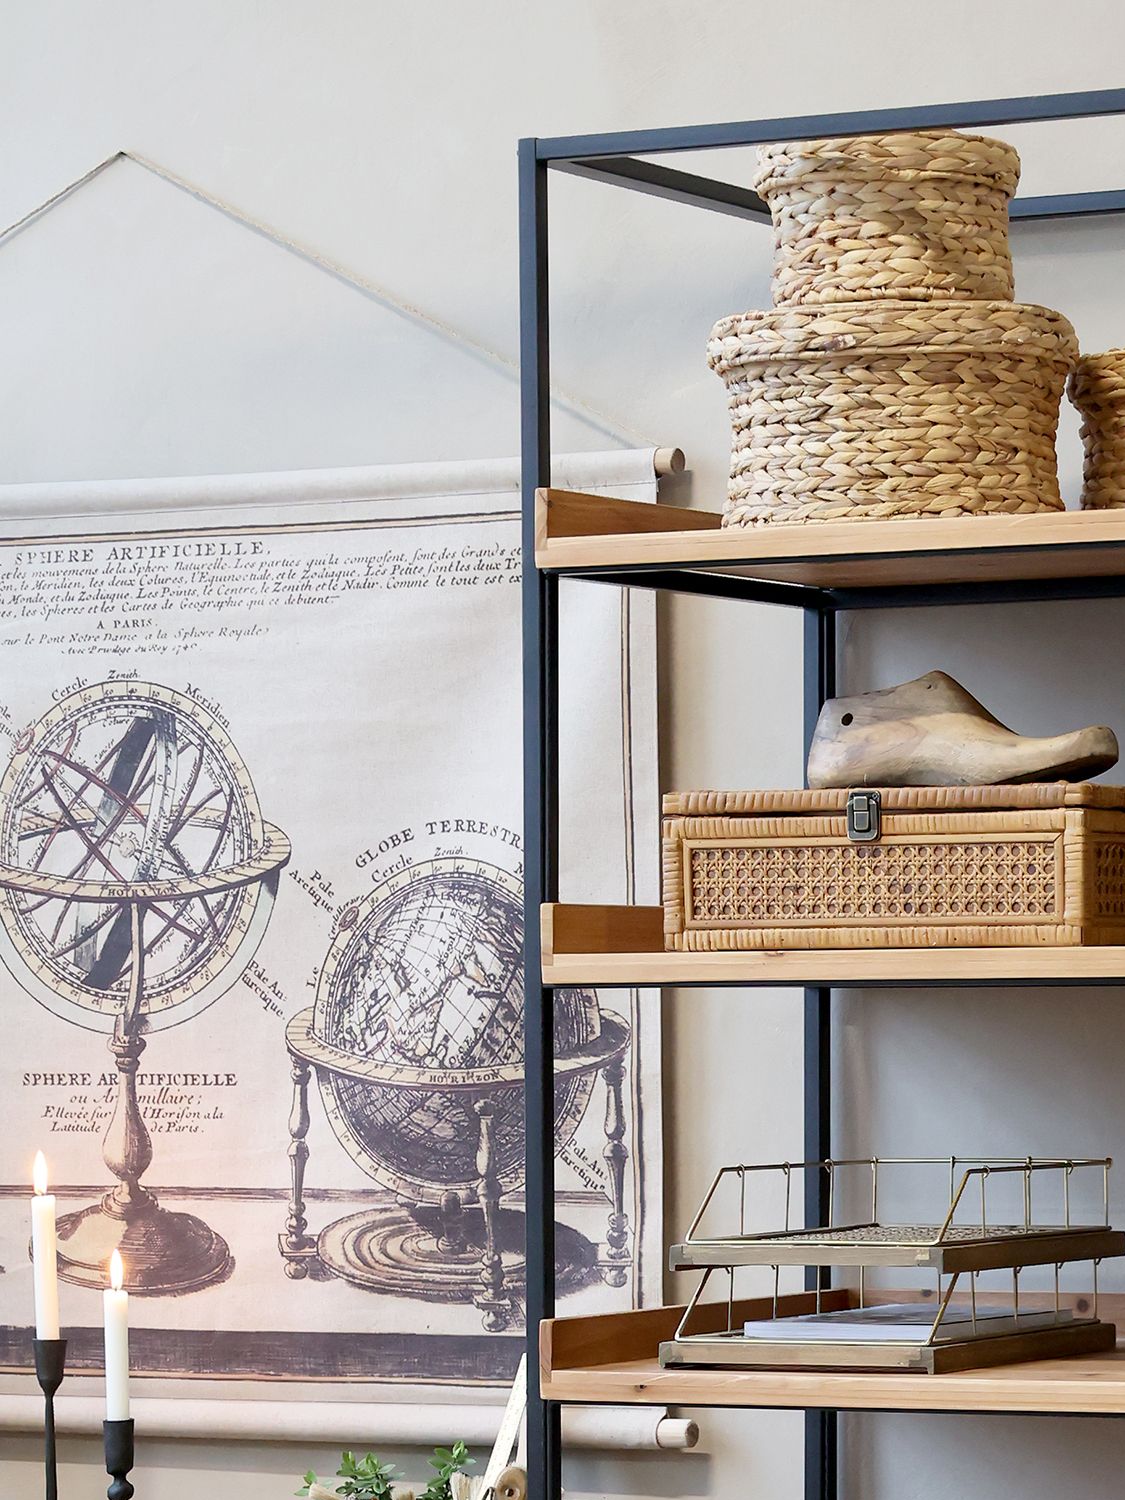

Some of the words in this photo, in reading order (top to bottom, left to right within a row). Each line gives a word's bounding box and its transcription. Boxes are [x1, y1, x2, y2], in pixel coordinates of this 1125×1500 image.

[15, 549, 94, 565] SPHERE
[130, 560, 168, 576] Sphere
[234, 558, 255, 570] Les
[89, 577, 105, 588] les
[107, 575, 136, 587] deux
[364, 566, 387, 577] Les
[473, 558, 502, 571] deux
[136, 588, 159, 600] Les
[202, 584, 214, 596] le
[272, 580, 312, 593] Zenith
[386, 575, 430, 589] Comme
[435, 575, 447, 587] le
[451, 574, 479, 585] tout
[484, 574, 506, 585] est
[21, 605, 37, 617] les
[40, 604, 83, 622] Spheres
[121, 601, 158, 614] Cartes
[161, 599, 174, 611] de
[24, 633, 36, 645] le
[103, 633, 138, 643] Dame
[156, 629, 169, 640] la
[97, 621, 105, 630] A
[51, 676, 89, 702] Cercle
[355, 828, 415, 869] GLOBE
[425, 819, 524, 852] TERRESTR
[371, 854, 413, 884] Cercle
[288, 869, 335, 915] Arctique
[310, 869, 336, 898] Pole
[248, 959, 269, 983] Pole
[305, 967, 318, 989] Le
[22, 1072, 91, 1087] SPHERE
[70, 1095, 88, 1104] ou
[50, 1119, 101, 1133] Latitude
[150, 1122, 163, 1133] de
[567, 1138, 589, 1163] Pole
